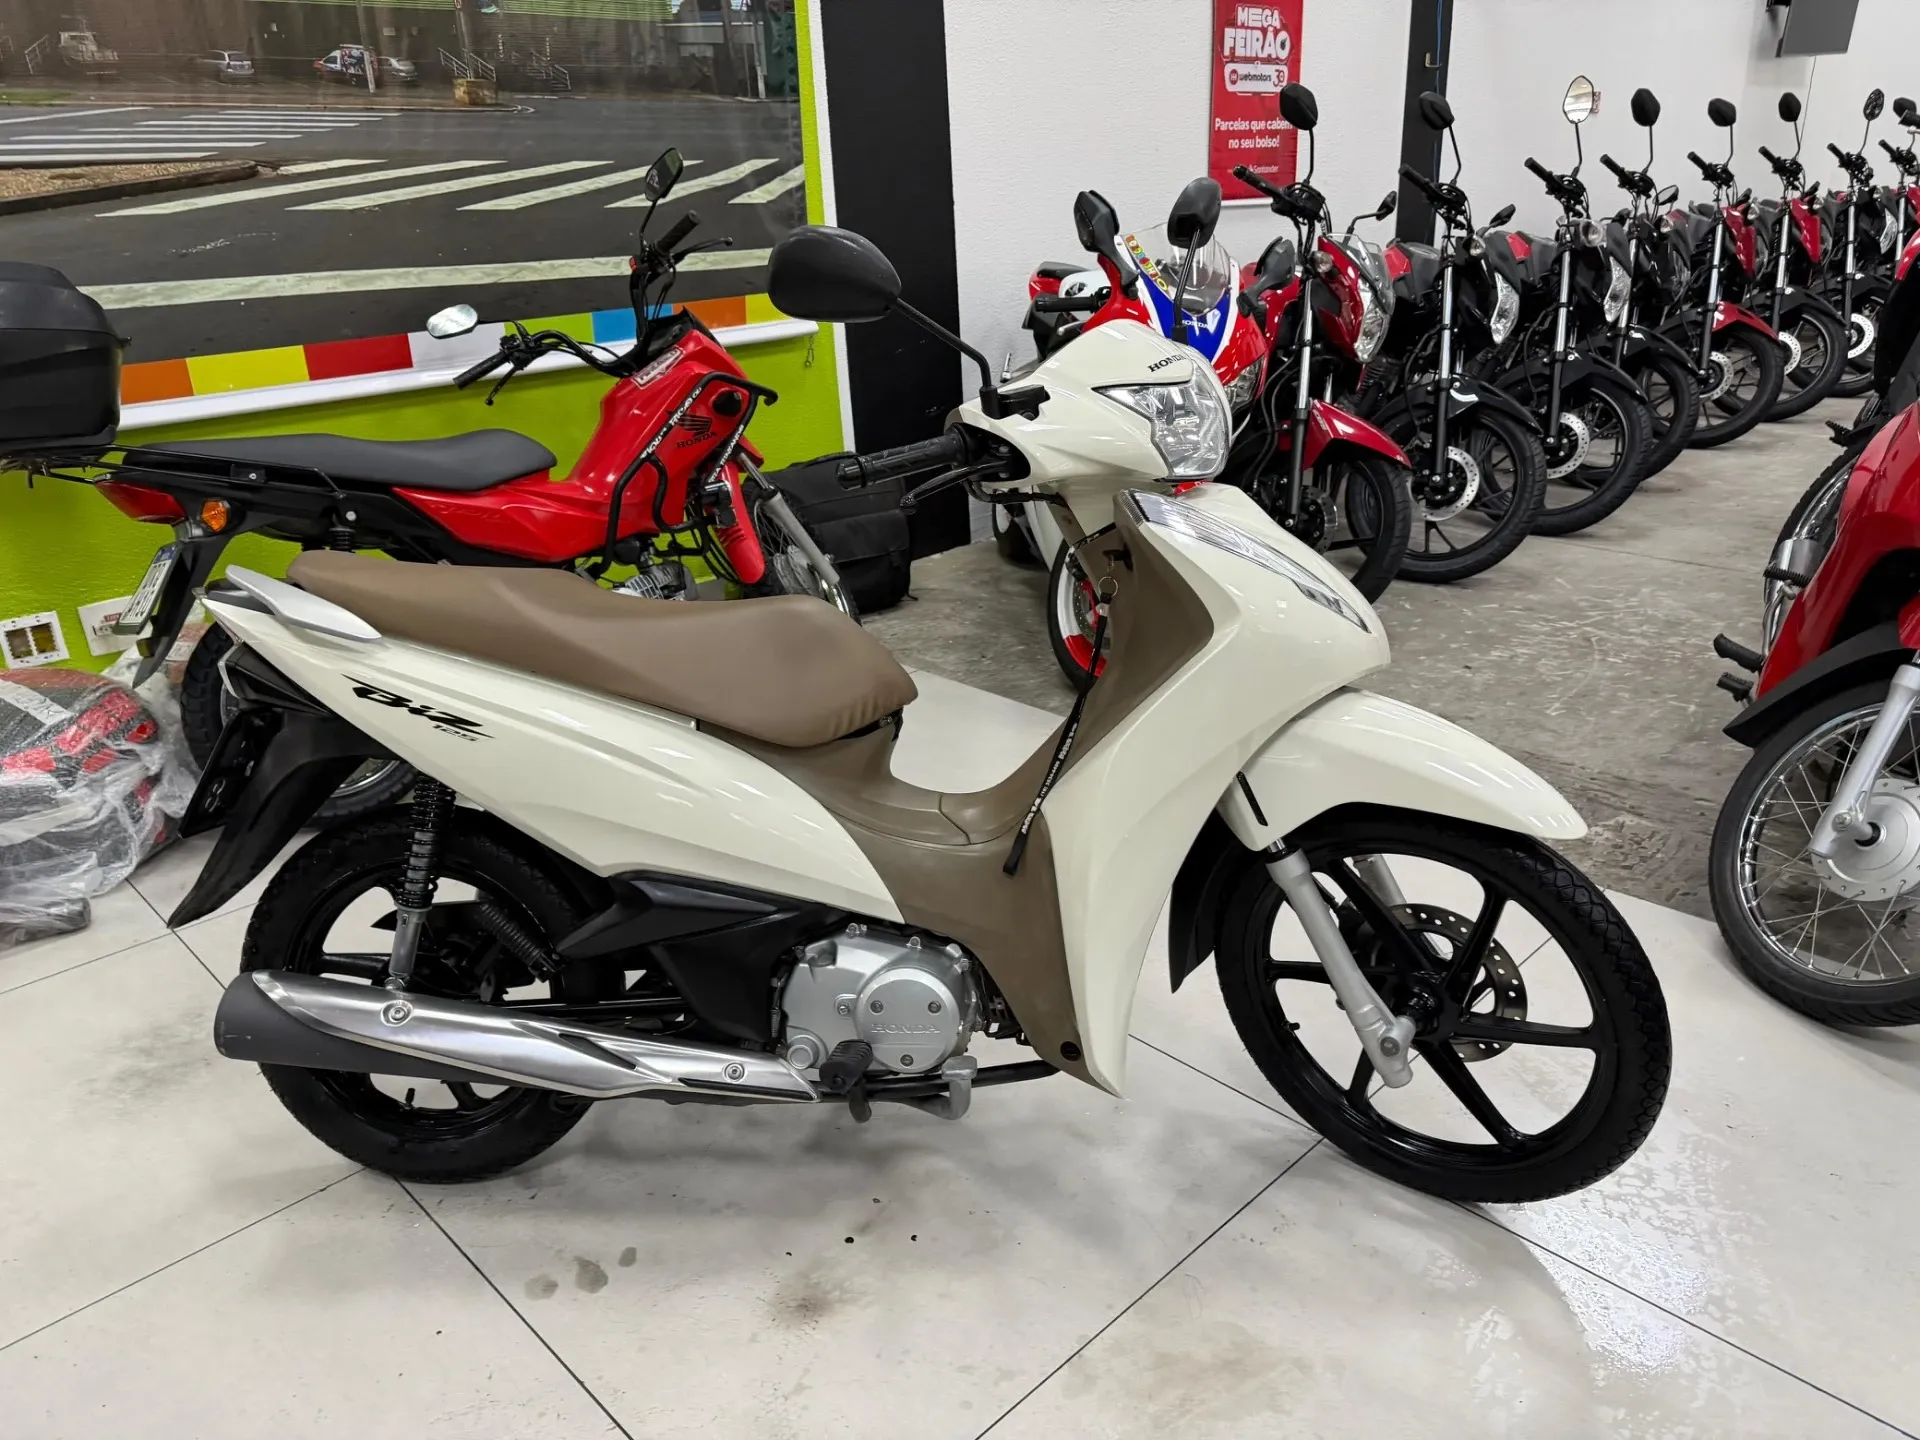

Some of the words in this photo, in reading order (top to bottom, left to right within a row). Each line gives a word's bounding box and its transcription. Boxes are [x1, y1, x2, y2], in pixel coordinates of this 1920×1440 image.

[1237, 6, 1280, 29] MEGA
[1223, 26, 1291, 60] FEIRÃO
[1239, 71, 1272, 82] webmotors
[1214, 117, 1250, 131] Parcelas
[1250, 121, 1266, 133] que
[1228, 139, 1239, 149] no
[1240, 139, 1255, 149] seu
[1255, 135, 1280, 148] bolso!
[1147, 353, 1187, 373] HONDA
[676, 432, 718, 450] HONDA
[871, 1023, 941, 1034] HONDA
